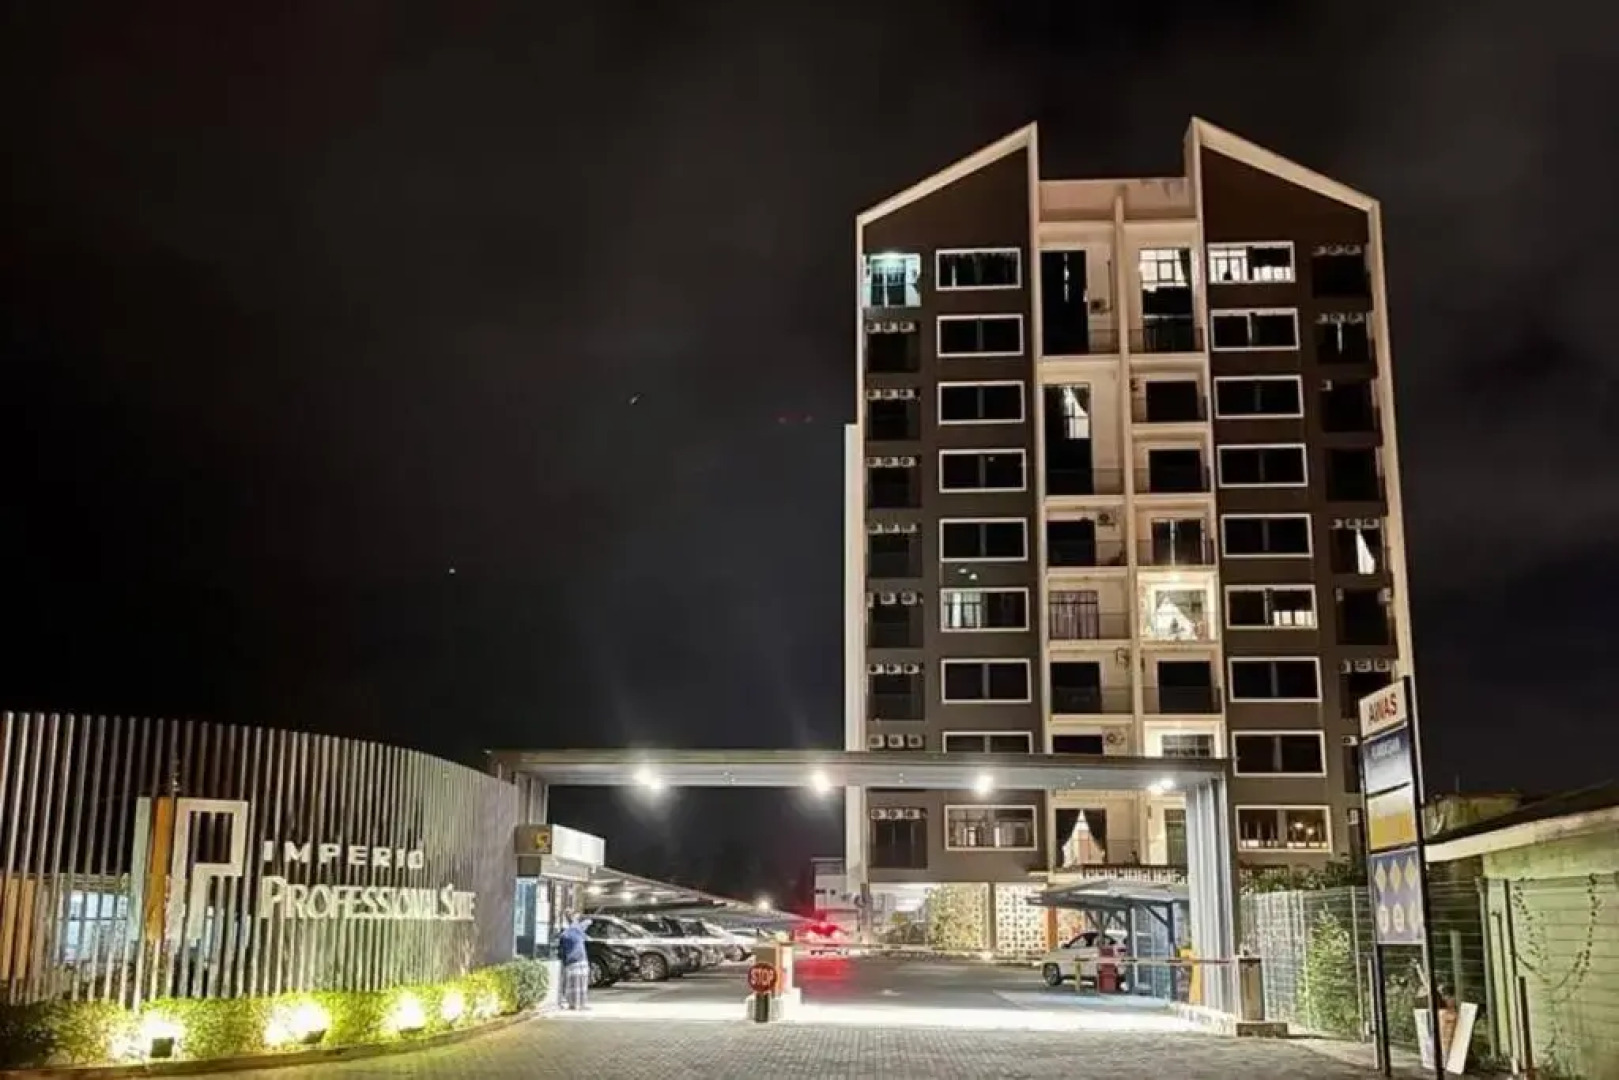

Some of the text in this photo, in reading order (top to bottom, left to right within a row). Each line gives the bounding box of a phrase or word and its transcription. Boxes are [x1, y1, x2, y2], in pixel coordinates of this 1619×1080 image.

[262, 841, 424, 869] IMPERIO
[260, 875, 439, 919] PROFESSIONAL
[750, 968, 774, 986] STOP
